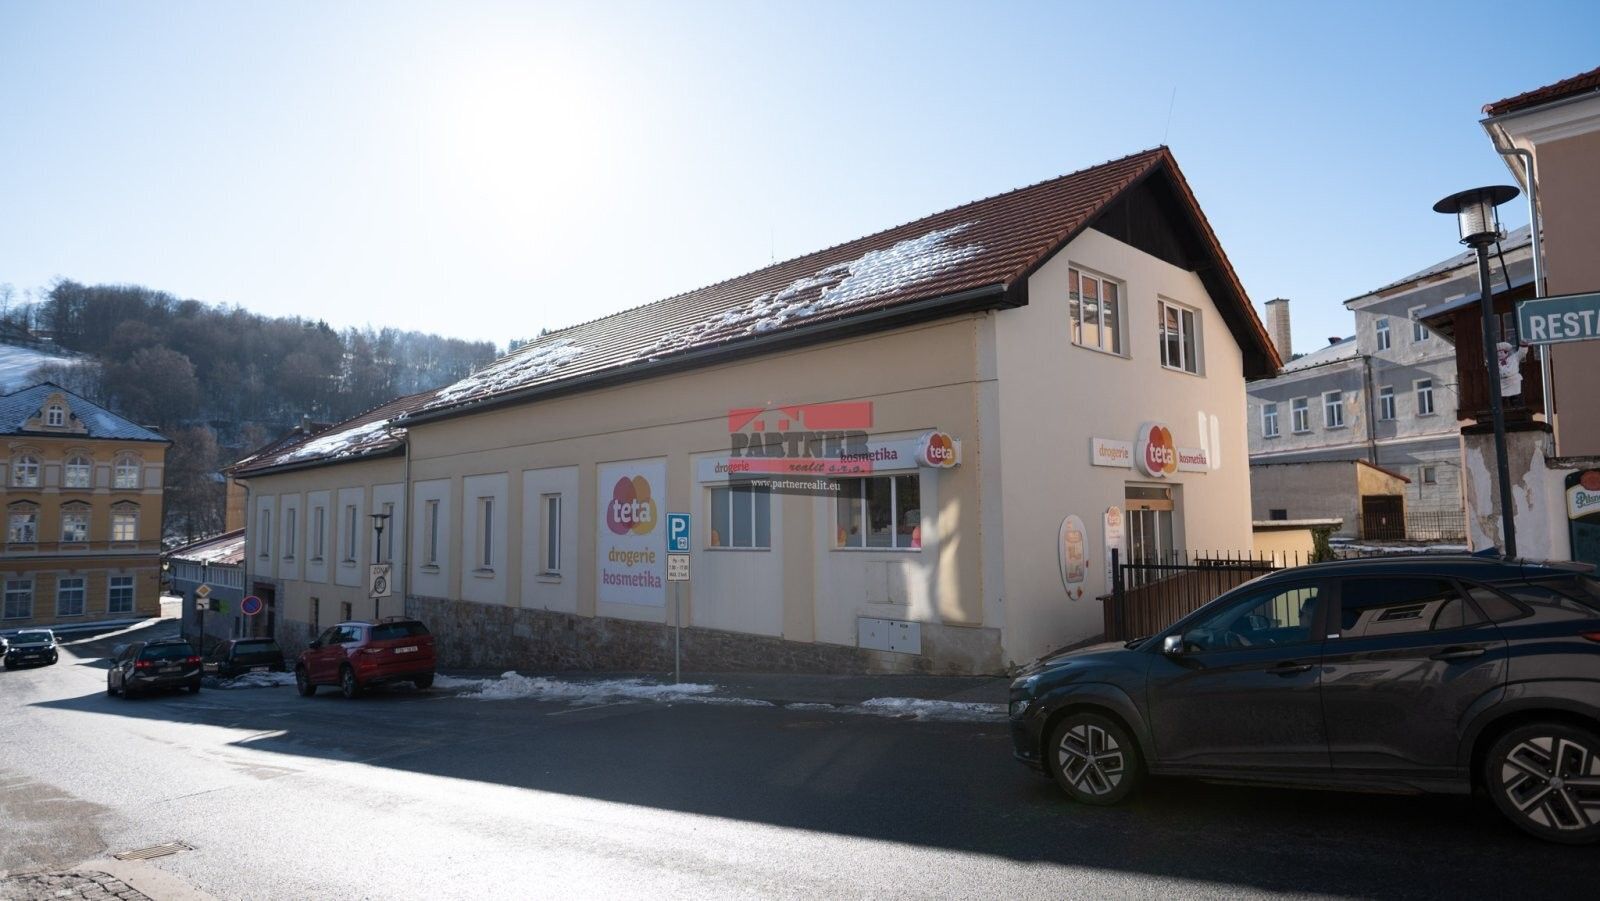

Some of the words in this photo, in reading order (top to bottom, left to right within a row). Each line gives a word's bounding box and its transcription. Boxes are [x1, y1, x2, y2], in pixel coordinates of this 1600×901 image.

[1530, 309, 1600, 340] REST
[840, 447, 898, 464] kosmetika
[930, 444, 953, 460] teta
[1099, 443, 1128, 460] drogerie
[1150, 443, 1173, 464] teta
[1179, 452, 1207, 465] kosmetika
[714, 460, 749, 474] drogerie
[613, 498, 651, 523] teta
[672, 517, 686, 540] P
[608, 546, 656, 567] drogerie
[602, 568, 662, 589] kosmetika
